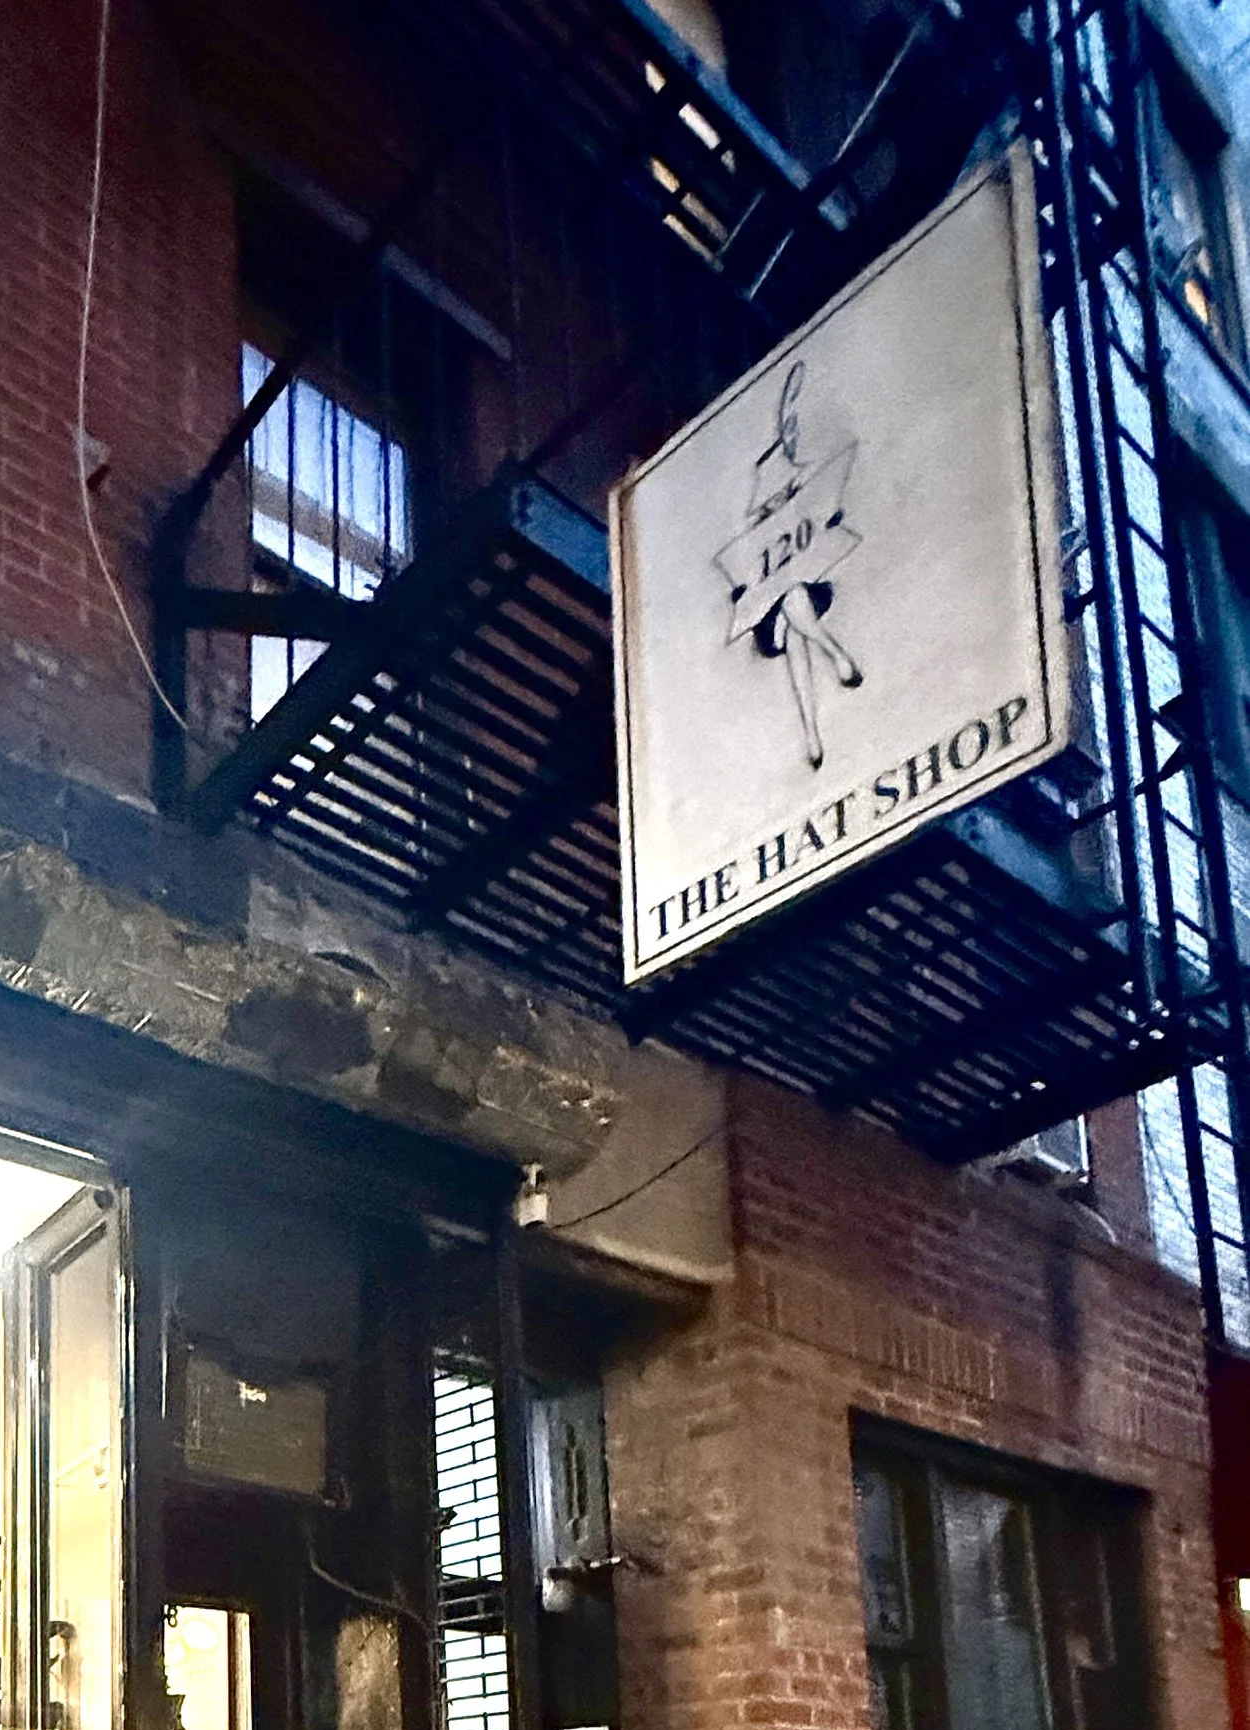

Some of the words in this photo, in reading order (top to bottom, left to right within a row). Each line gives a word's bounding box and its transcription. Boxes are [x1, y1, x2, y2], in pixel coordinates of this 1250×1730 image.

[758, 518, 813, 582] 120
[649, 859, 740, 941] THE
[754, 793, 857, 885] HAT
[873, 696, 1028, 819] SHOP
